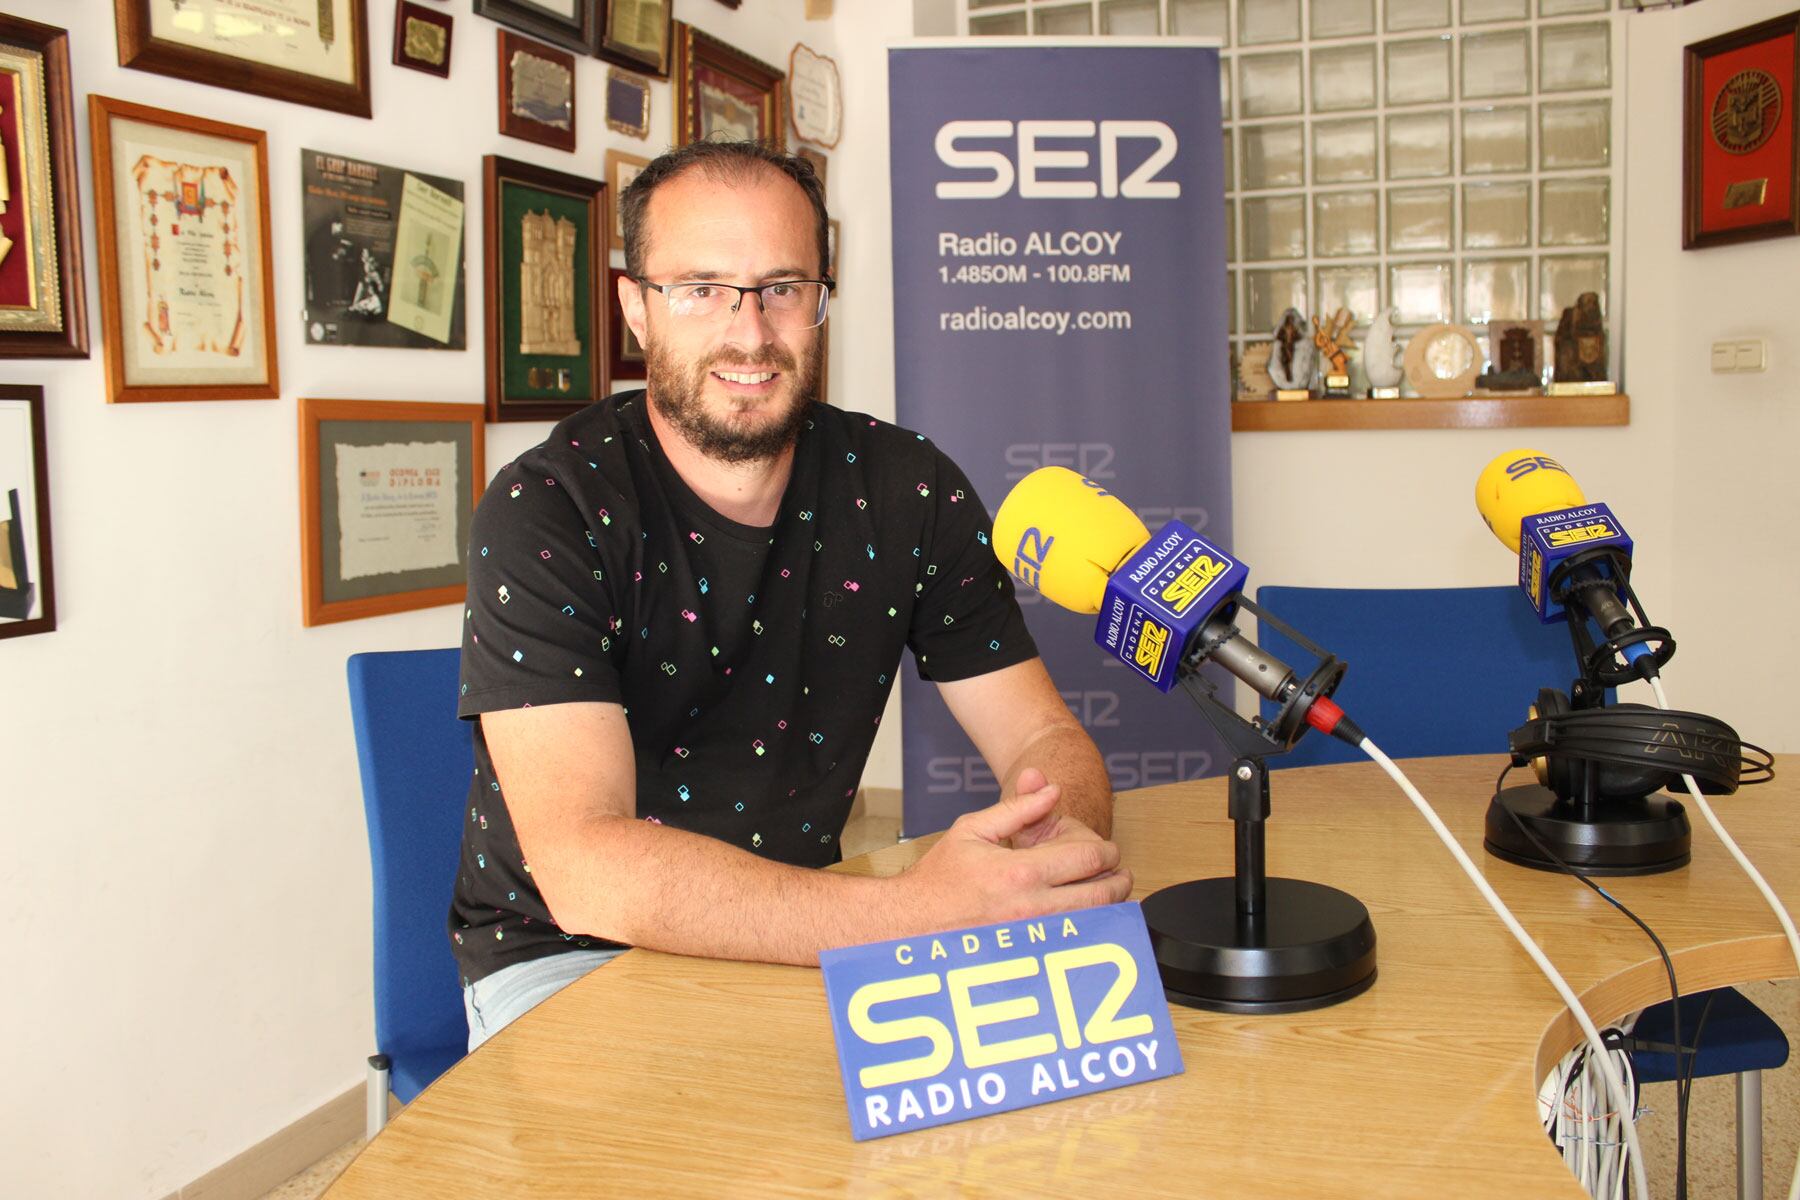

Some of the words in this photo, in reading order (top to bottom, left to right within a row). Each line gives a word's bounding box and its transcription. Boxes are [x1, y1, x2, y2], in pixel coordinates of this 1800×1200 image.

[935, 120, 1181, 199] SER
[938, 232, 1017, 256] Radio
[1024, 231, 1122, 255] ALCOY
[1047, 264, 1130, 283] 100.8FM
[940, 307, 1132, 335] radioalcoy.com
[1536, 513, 1566, 525] RADIO
[1568, 507, 1598, 519] ALCOY
[1543, 518, 1607, 533] CADENA
[1549, 524, 1614, 547] SER
[1014, 527, 1055, 590] ER
[1129, 556, 1159, 583] RADIO
[1155, 531, 1184, 564] ALCOY
[1149, 546, 1202, 595] CADENA
[1161, 555, 1226, 613] SER
[1106, 619, 1118, 648] RADIO
[1113, 596, 1126, 623] ALCOY
[1126, 611, 1143, 660] CADENA
[1135, 620, 1168, 676] SER
[927, 756, 1002, 793] SE
[895, 918, 1079, 965] CADENA
[847, 943, 1154, 1089] SER
[865, 1073, 1006, 1129] RADIO
[1031, 1040, 1159, 1096] ALCOY
